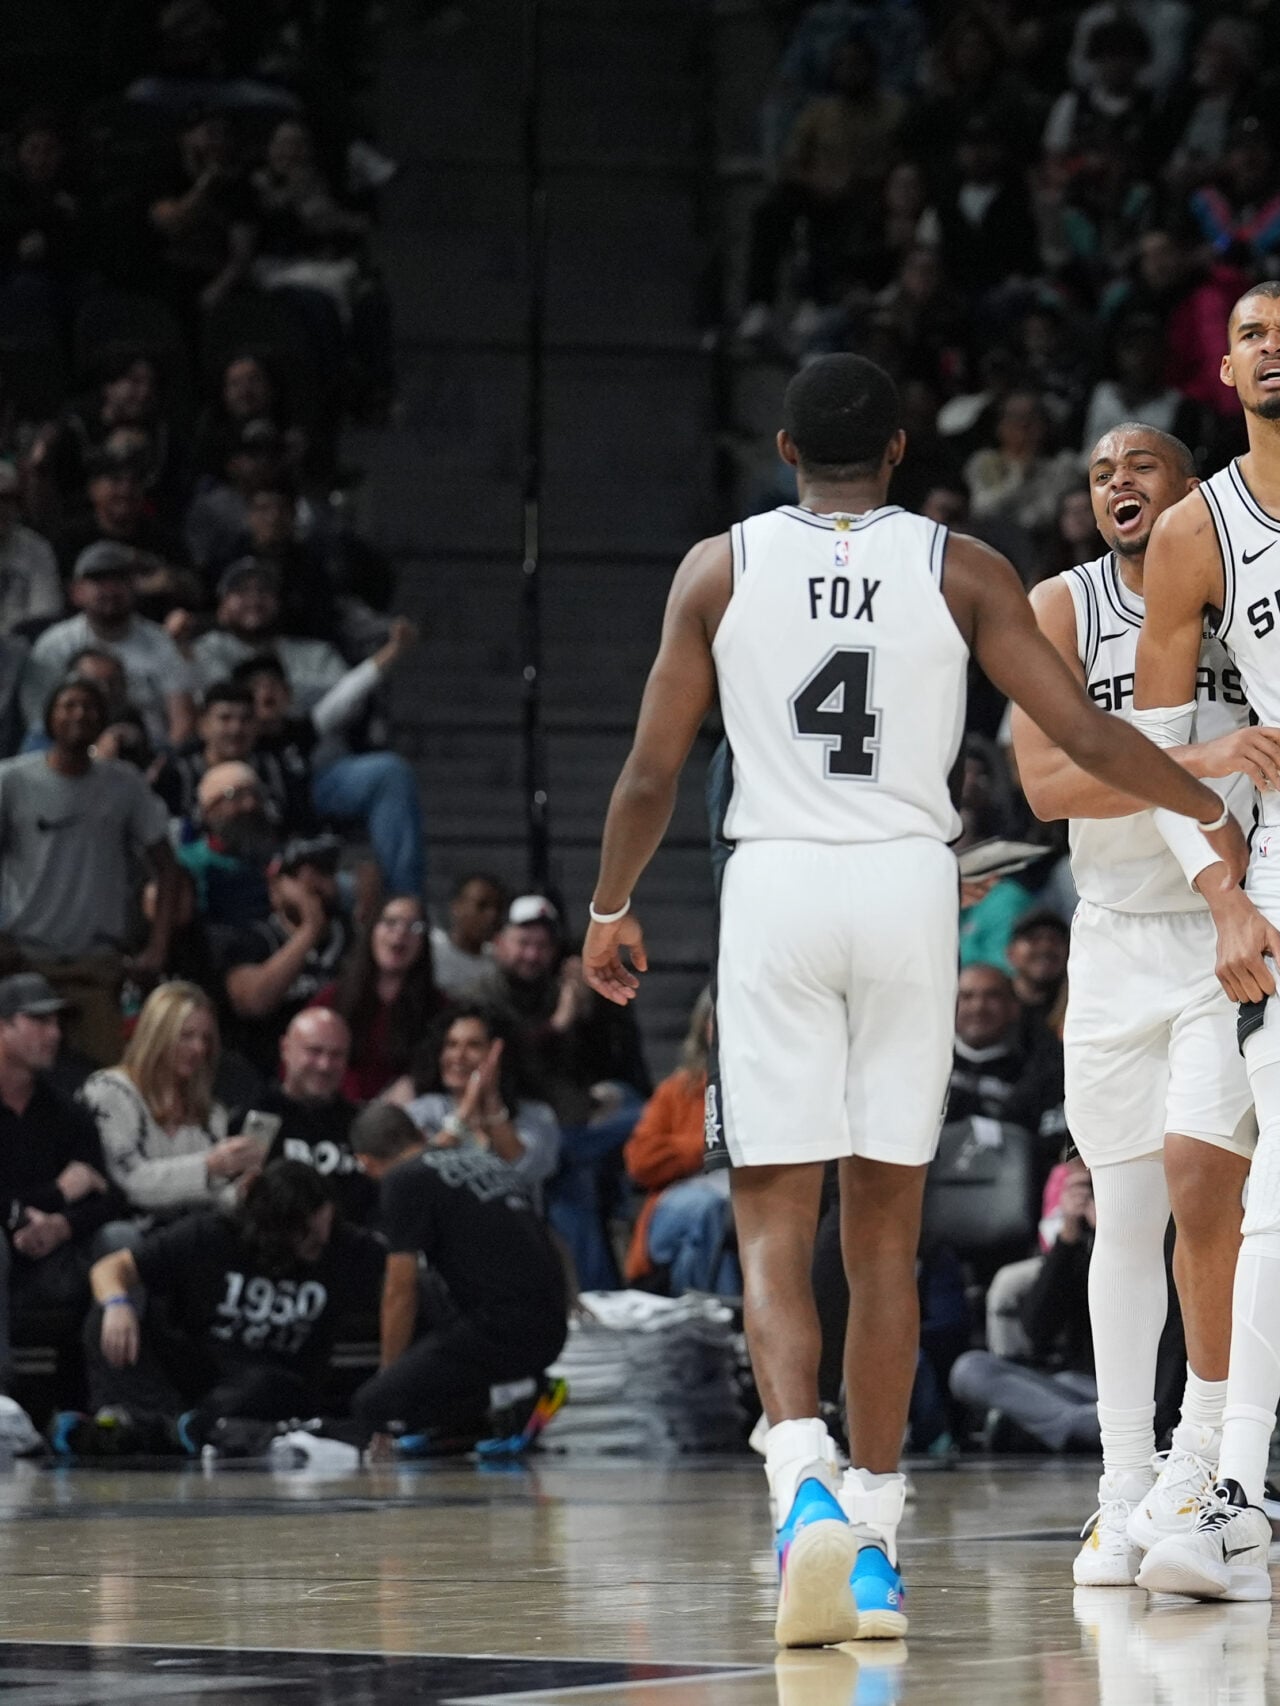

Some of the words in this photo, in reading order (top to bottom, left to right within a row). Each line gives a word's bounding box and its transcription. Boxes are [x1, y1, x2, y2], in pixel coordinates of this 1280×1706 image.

[808, 576, 881, 622] FOX
[787, 645, 883, 783] 4
[1088, 667, 1249, 712] SPRS
[216, 1270, 328, 1326] 1950
